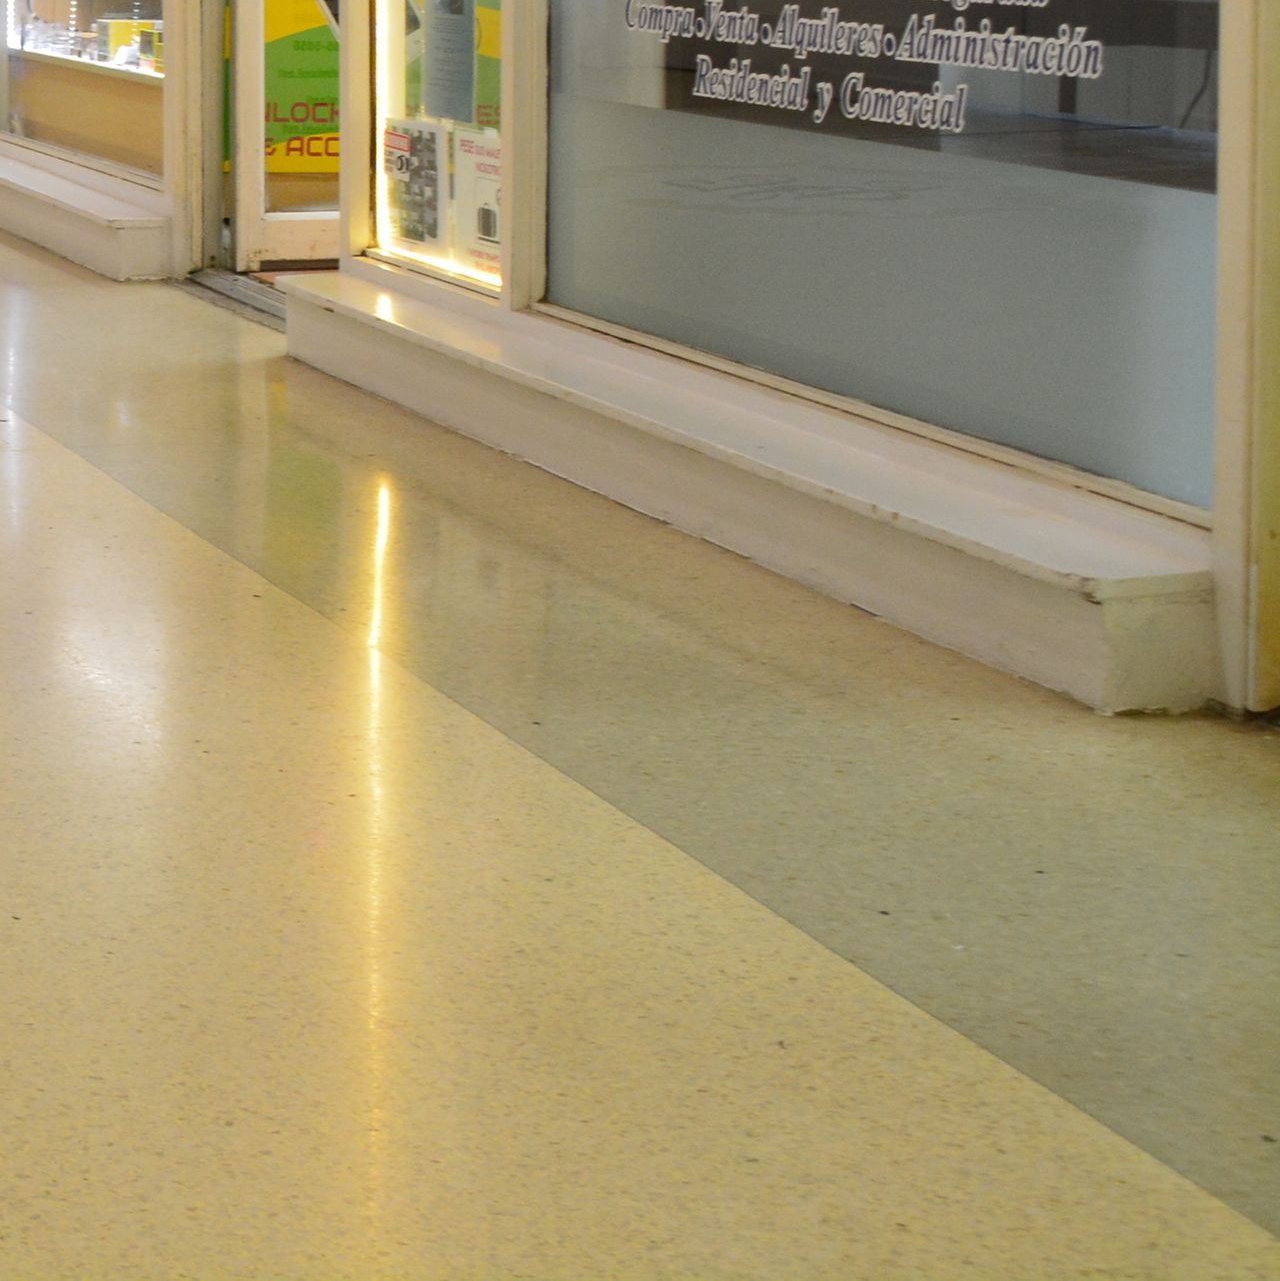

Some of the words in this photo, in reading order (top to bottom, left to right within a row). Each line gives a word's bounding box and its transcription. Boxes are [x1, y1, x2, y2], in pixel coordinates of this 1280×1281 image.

[895, 14, 1104, 79] Administración
[693, 53, 812, 111] Residencial
[813, 82, 834, 123] y
[840, 71, 968, 133] Comercial
